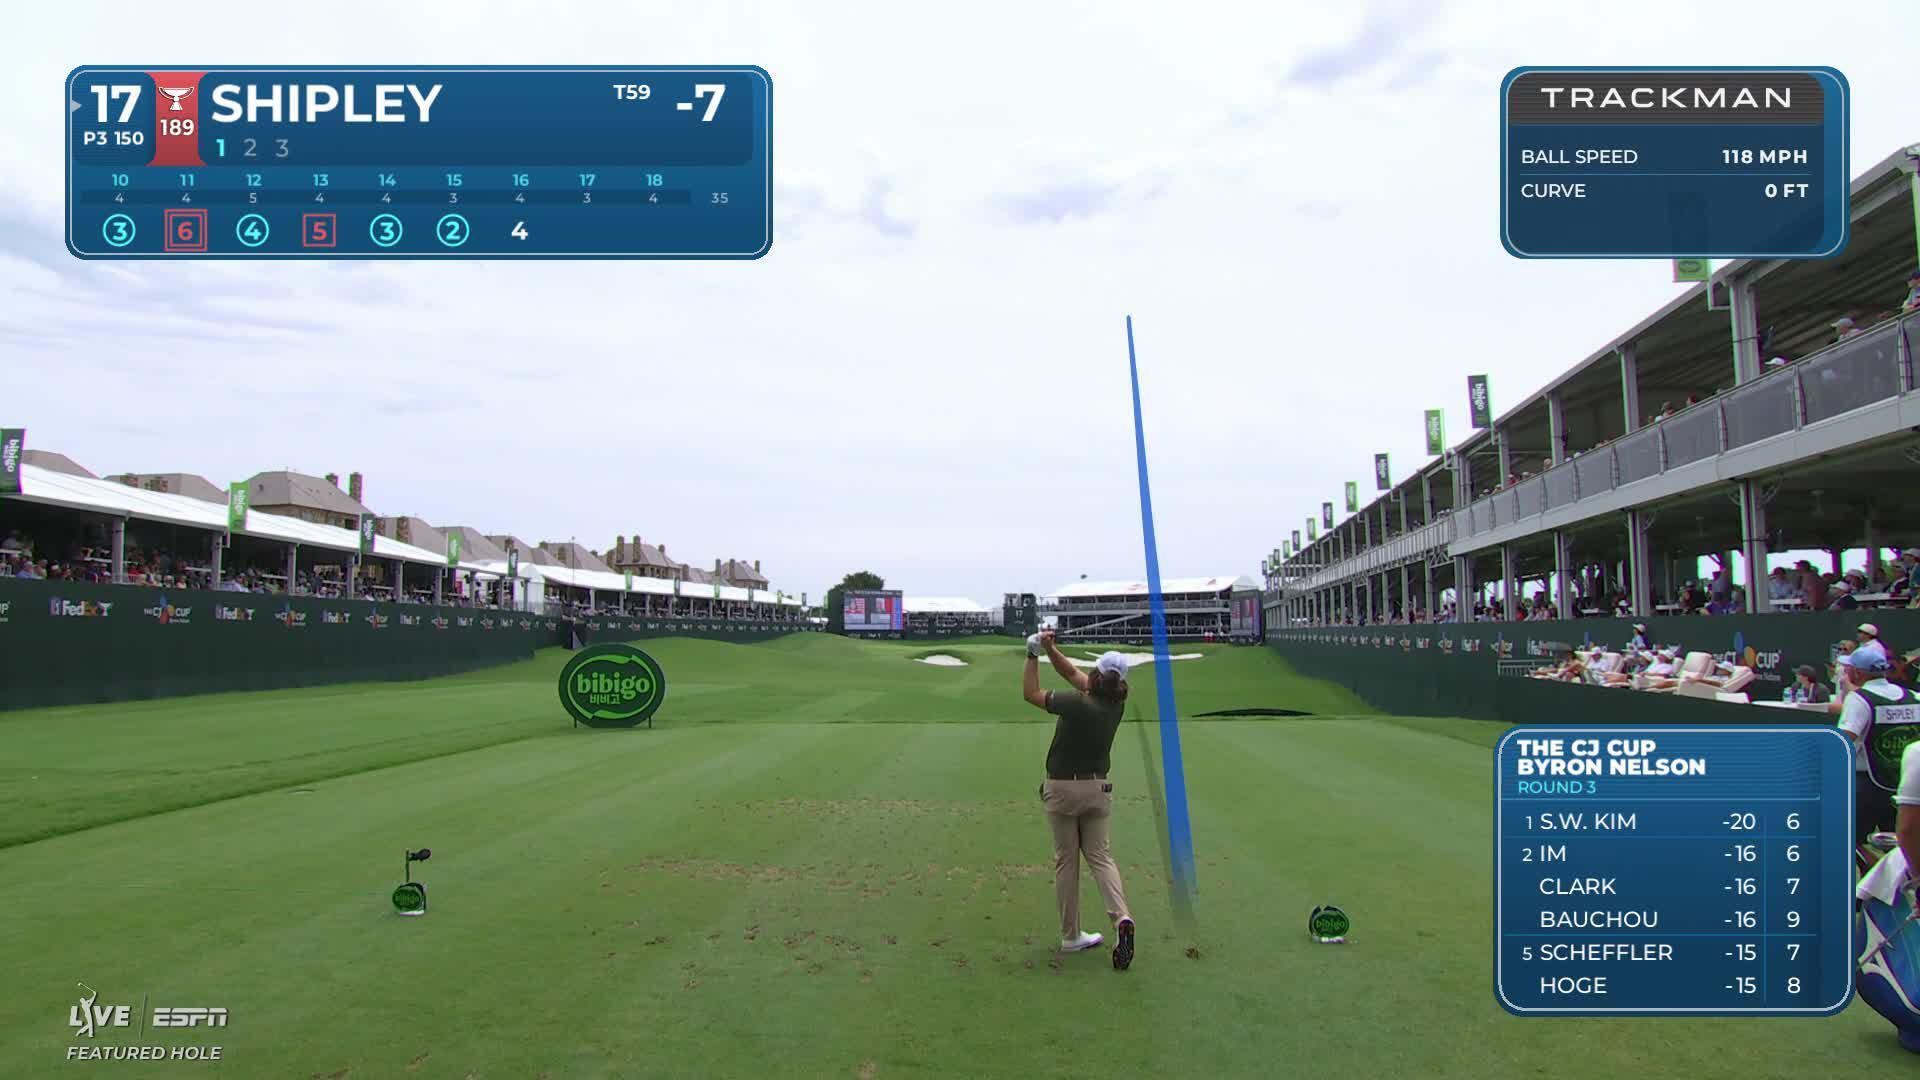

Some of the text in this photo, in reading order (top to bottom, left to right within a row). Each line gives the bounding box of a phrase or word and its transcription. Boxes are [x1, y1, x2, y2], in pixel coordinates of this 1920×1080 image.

[1756, 651, 1780, 669] CUP
[577, 672, 650, 700] bibigo
[590, 694, 620, 705] 비비고
